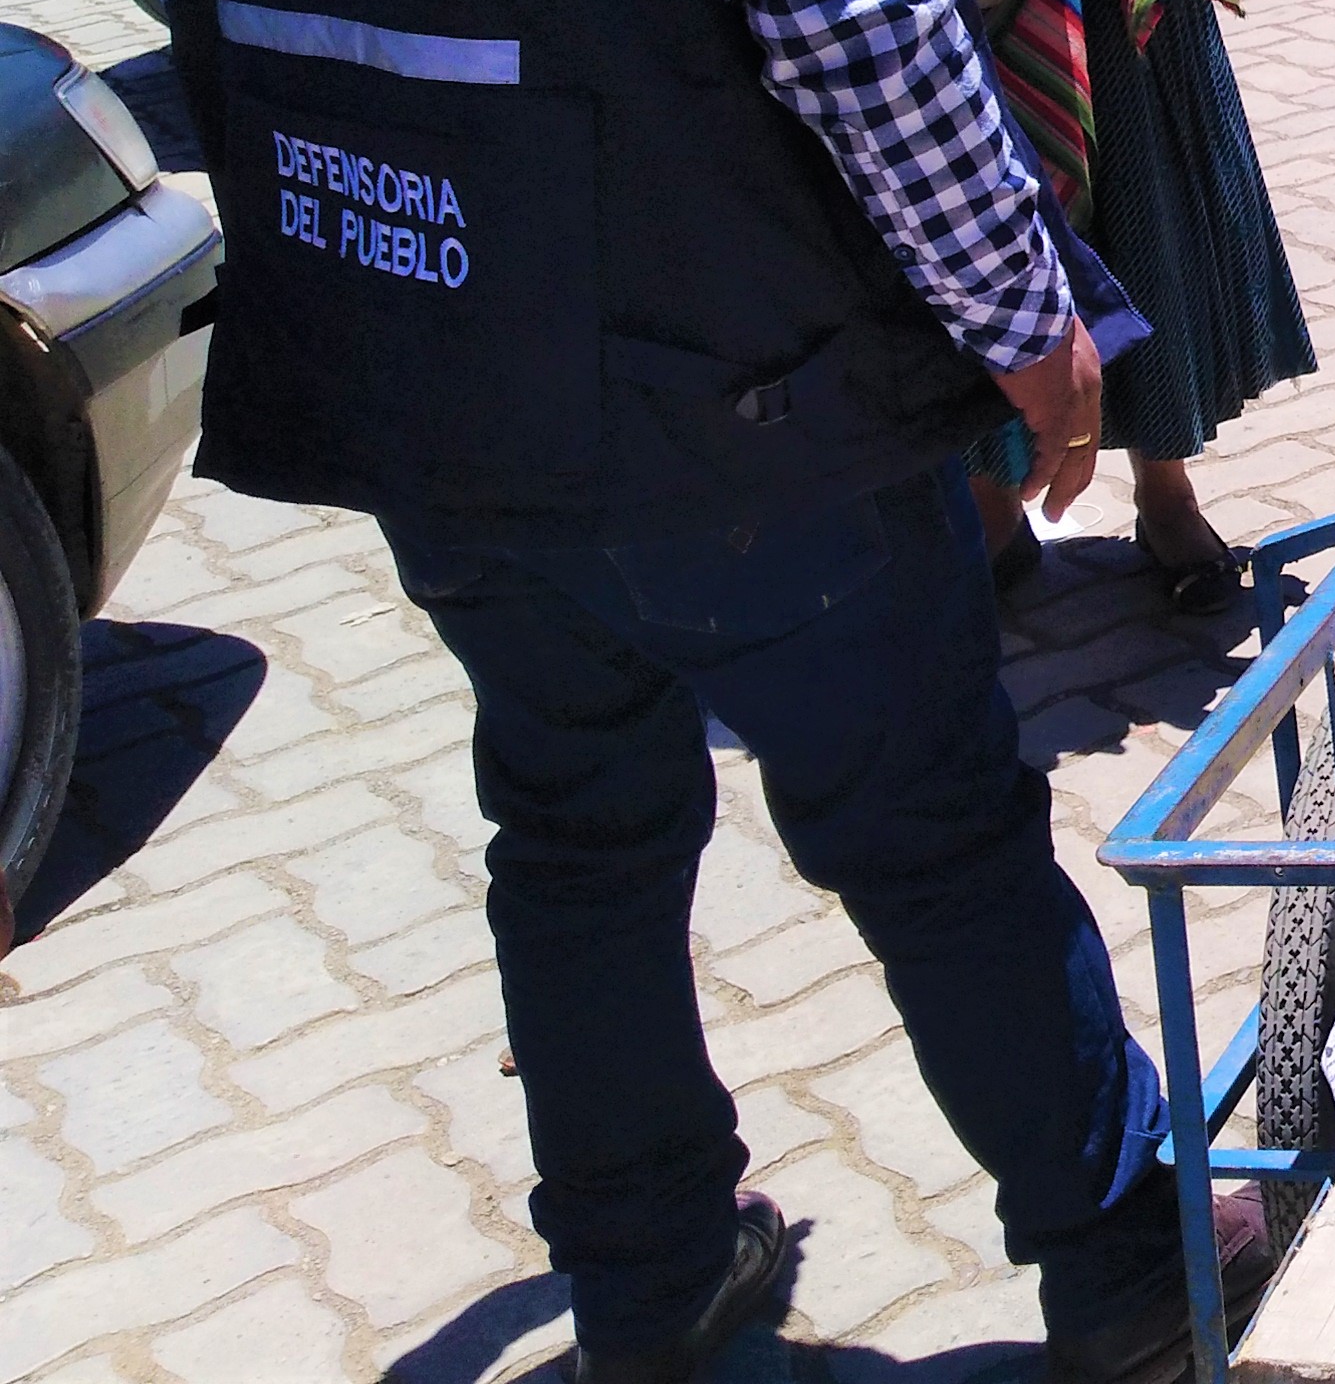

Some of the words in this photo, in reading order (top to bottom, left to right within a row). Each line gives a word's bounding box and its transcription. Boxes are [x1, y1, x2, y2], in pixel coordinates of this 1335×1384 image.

[272, 129, 467, 228] DEFENSORIA
[280, 188, 327, 250] DEL
[340, 208, 469, 289] PUEBLO
